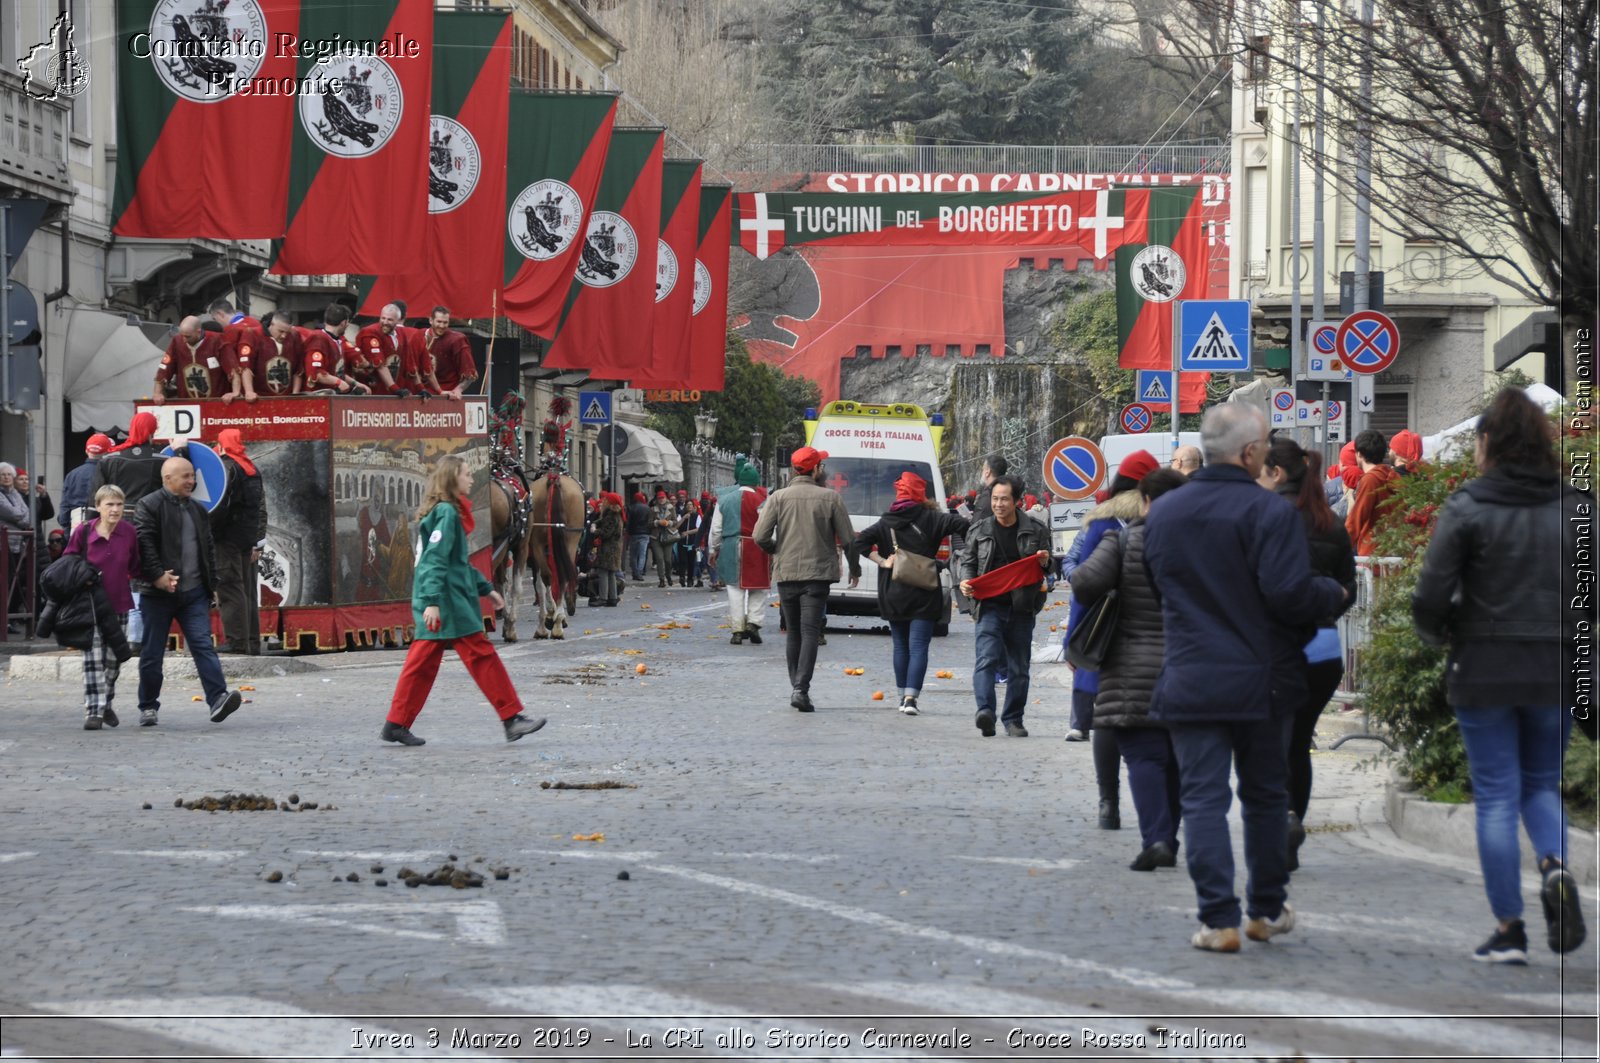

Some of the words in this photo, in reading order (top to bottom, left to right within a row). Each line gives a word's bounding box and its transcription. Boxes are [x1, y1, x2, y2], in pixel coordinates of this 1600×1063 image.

[361, 57, 379, 72] DEL
[379, 70, 398, 139] BORGHETTO
[443, 121, 460, 136] DEL
[458, 135, 477, 196] BORGHETTO
[521, 182, 552, 203] TUCHINI
[555, 184, 571, 198] DEL
[561, 198, 580, 247] BORGHETTO
[792, 205, 882, 233] TUCHINI
[896, 210, 924, 229] DEL
[939, 204, 1072, 232] BORGHETTO
[608, 215, 623, 228] DEL
[619, 226, 635, 275] BORGHETTO
[645, 388, 702, 403] MERLO
[175, 410, 193, 434] D
[202, 417, 206, 425] I
[207, 417, 253, 426] DIFENSORI
[254, 417, 272, 425] DEL
[273, 415, 326, 424] BORGHETTO
[342, 409, 346, 427] I
[347, 409, 394, 428] DIFENSORI
[395, 412, 412, 428] DEL
[413, 410, 463, 428] BORGHETTO
[478, 406, 485, 430] D
[825, 429, 851, 437] CROCE
[854, 430, 882, 438] ROSSA
[885, 431, 923, 441] ITALIANA
[860, 441, 886, 449] IVREA
